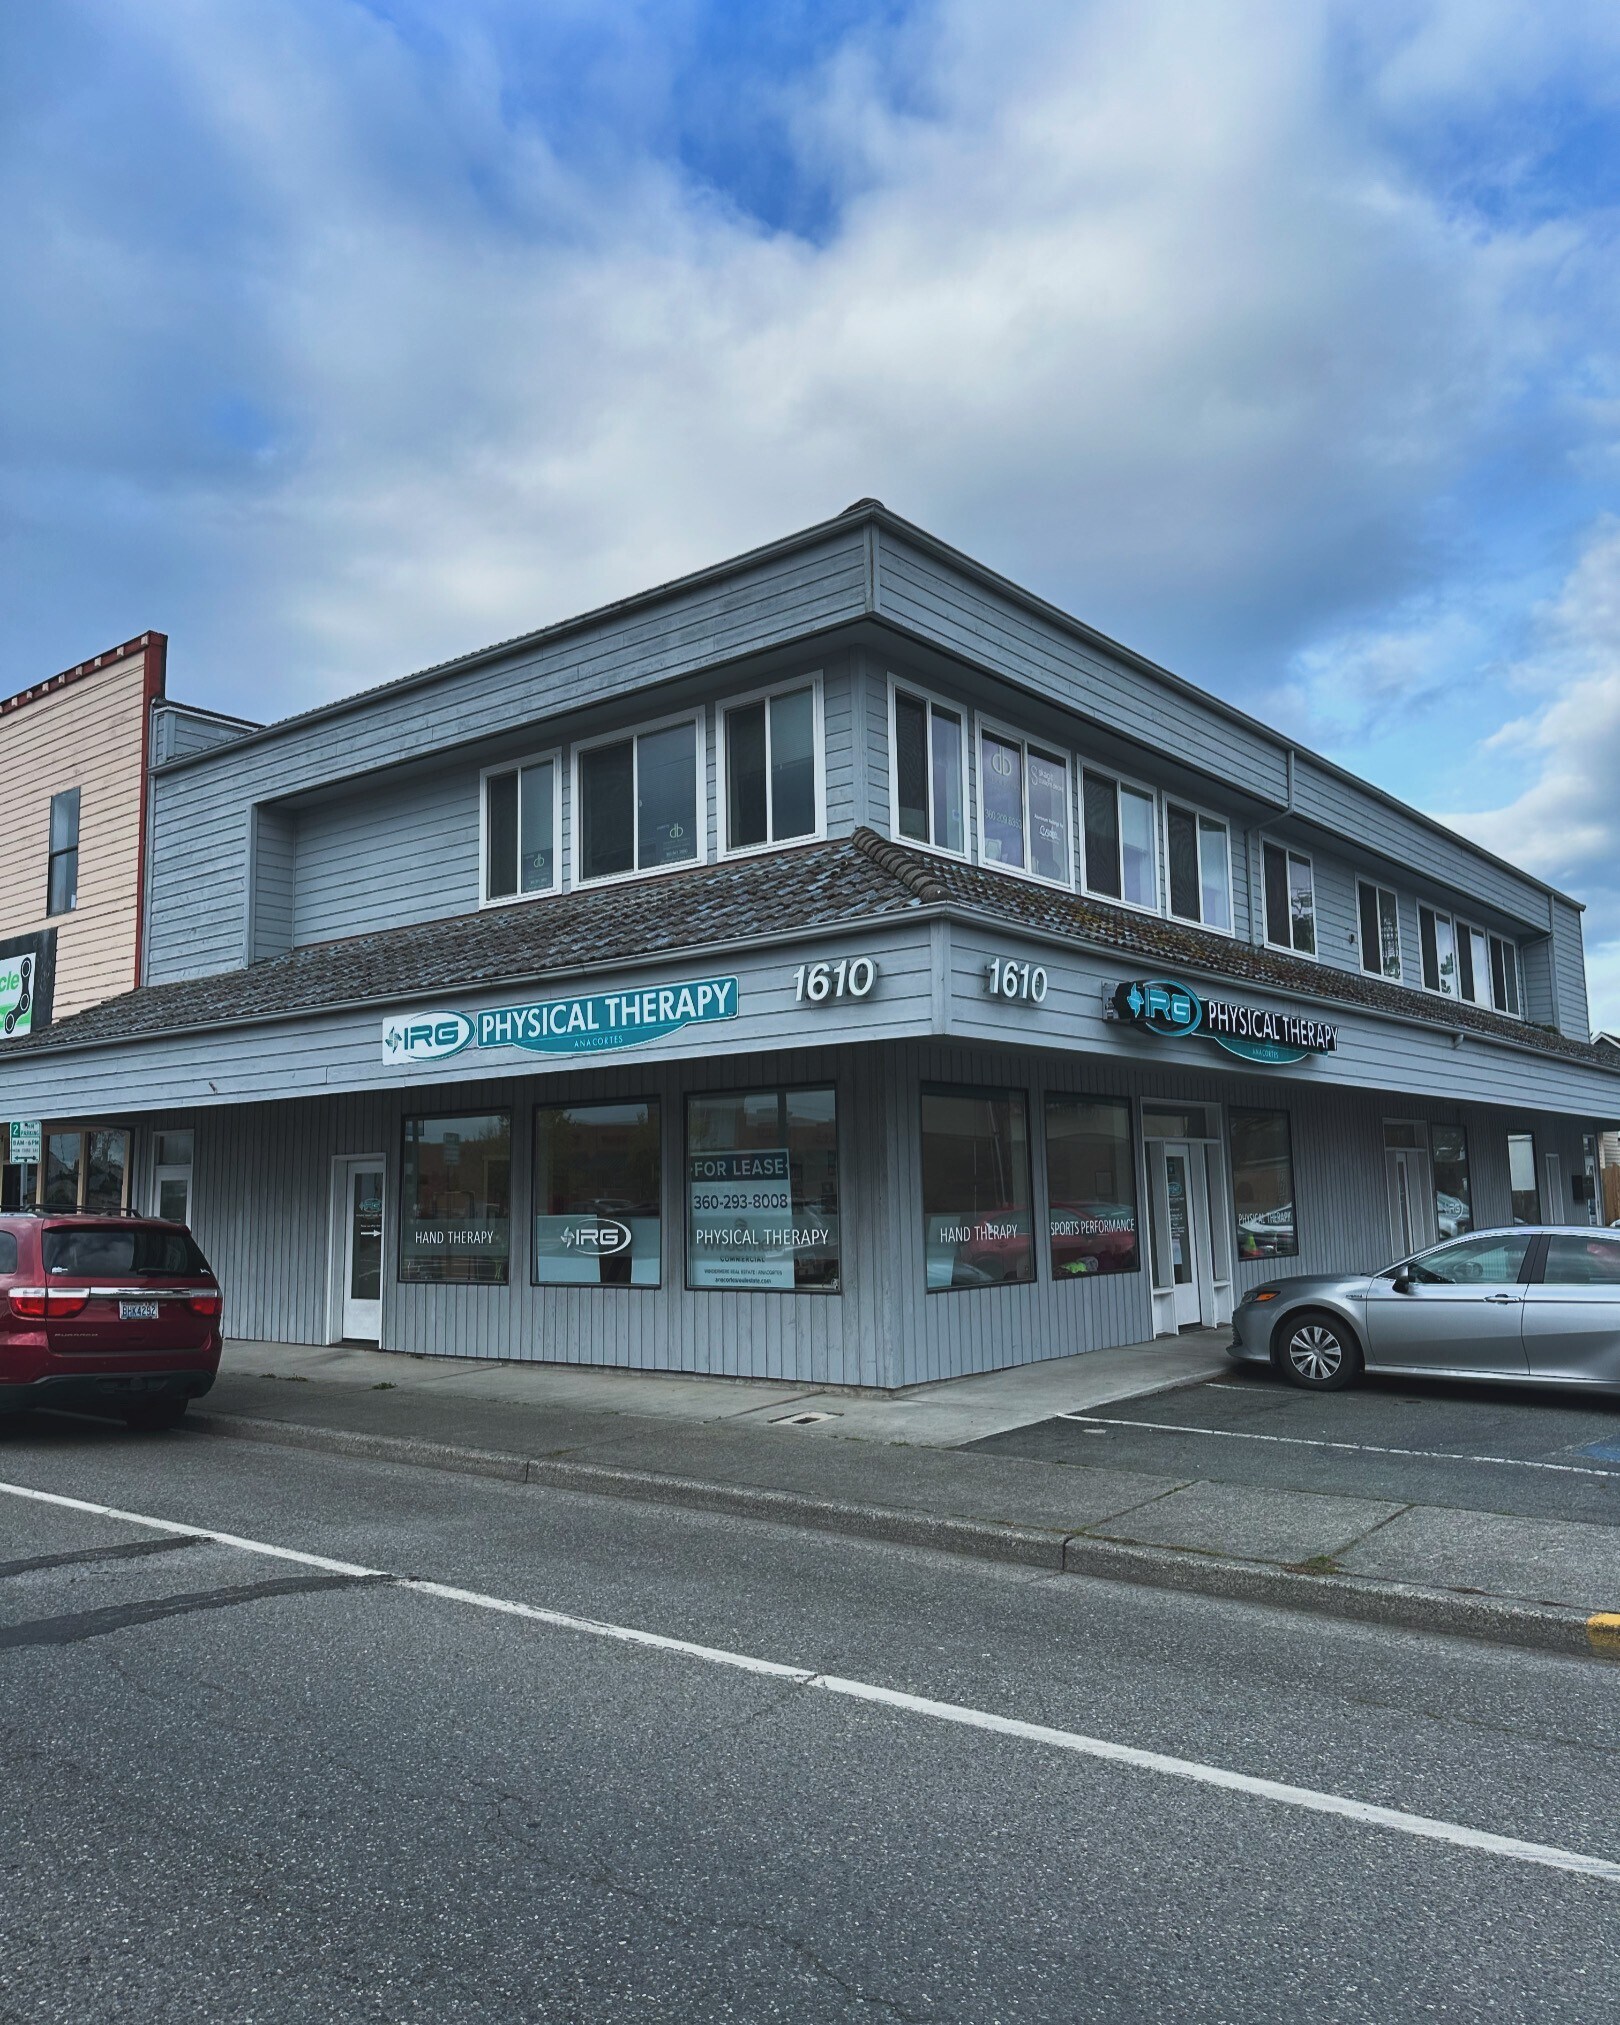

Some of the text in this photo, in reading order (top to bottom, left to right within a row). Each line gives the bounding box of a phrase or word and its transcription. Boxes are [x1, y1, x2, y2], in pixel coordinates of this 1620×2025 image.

[793, 957, 877, 1002] 1610
[989, 957, 1048, 1003] 1610
[404, 982, 733, 1050] IRG PHYSICAL THERAPY
[1144, 987, 1339, 1051] IRG PHYSICAL THERAPY
[573, 1034, 624, 1048] ANACORTES
[1252, 1048, 1279, 1060] ANACORTES
[13, 1124, 19, 1136] 2
[694, 1158, 784, 1177] FOR LEASE
[693, 1193, 788, 1210] 360-293-8008
[1050, 1217, 1135, 1236] SPORTS PERFORMANCE
[1238, 1212, 1266, 1226] PHYSICAL
[415, 1230, 494, 1244] HAND THERAPY
[576, 1228, 619, 1246] IRG
[696, 1228, 829, 1245] PHYSICAL THERAPY
[940, 1223, 1018, 1243] HAND THERAPY
[122, 1305, 156, 1316] BHK4292
